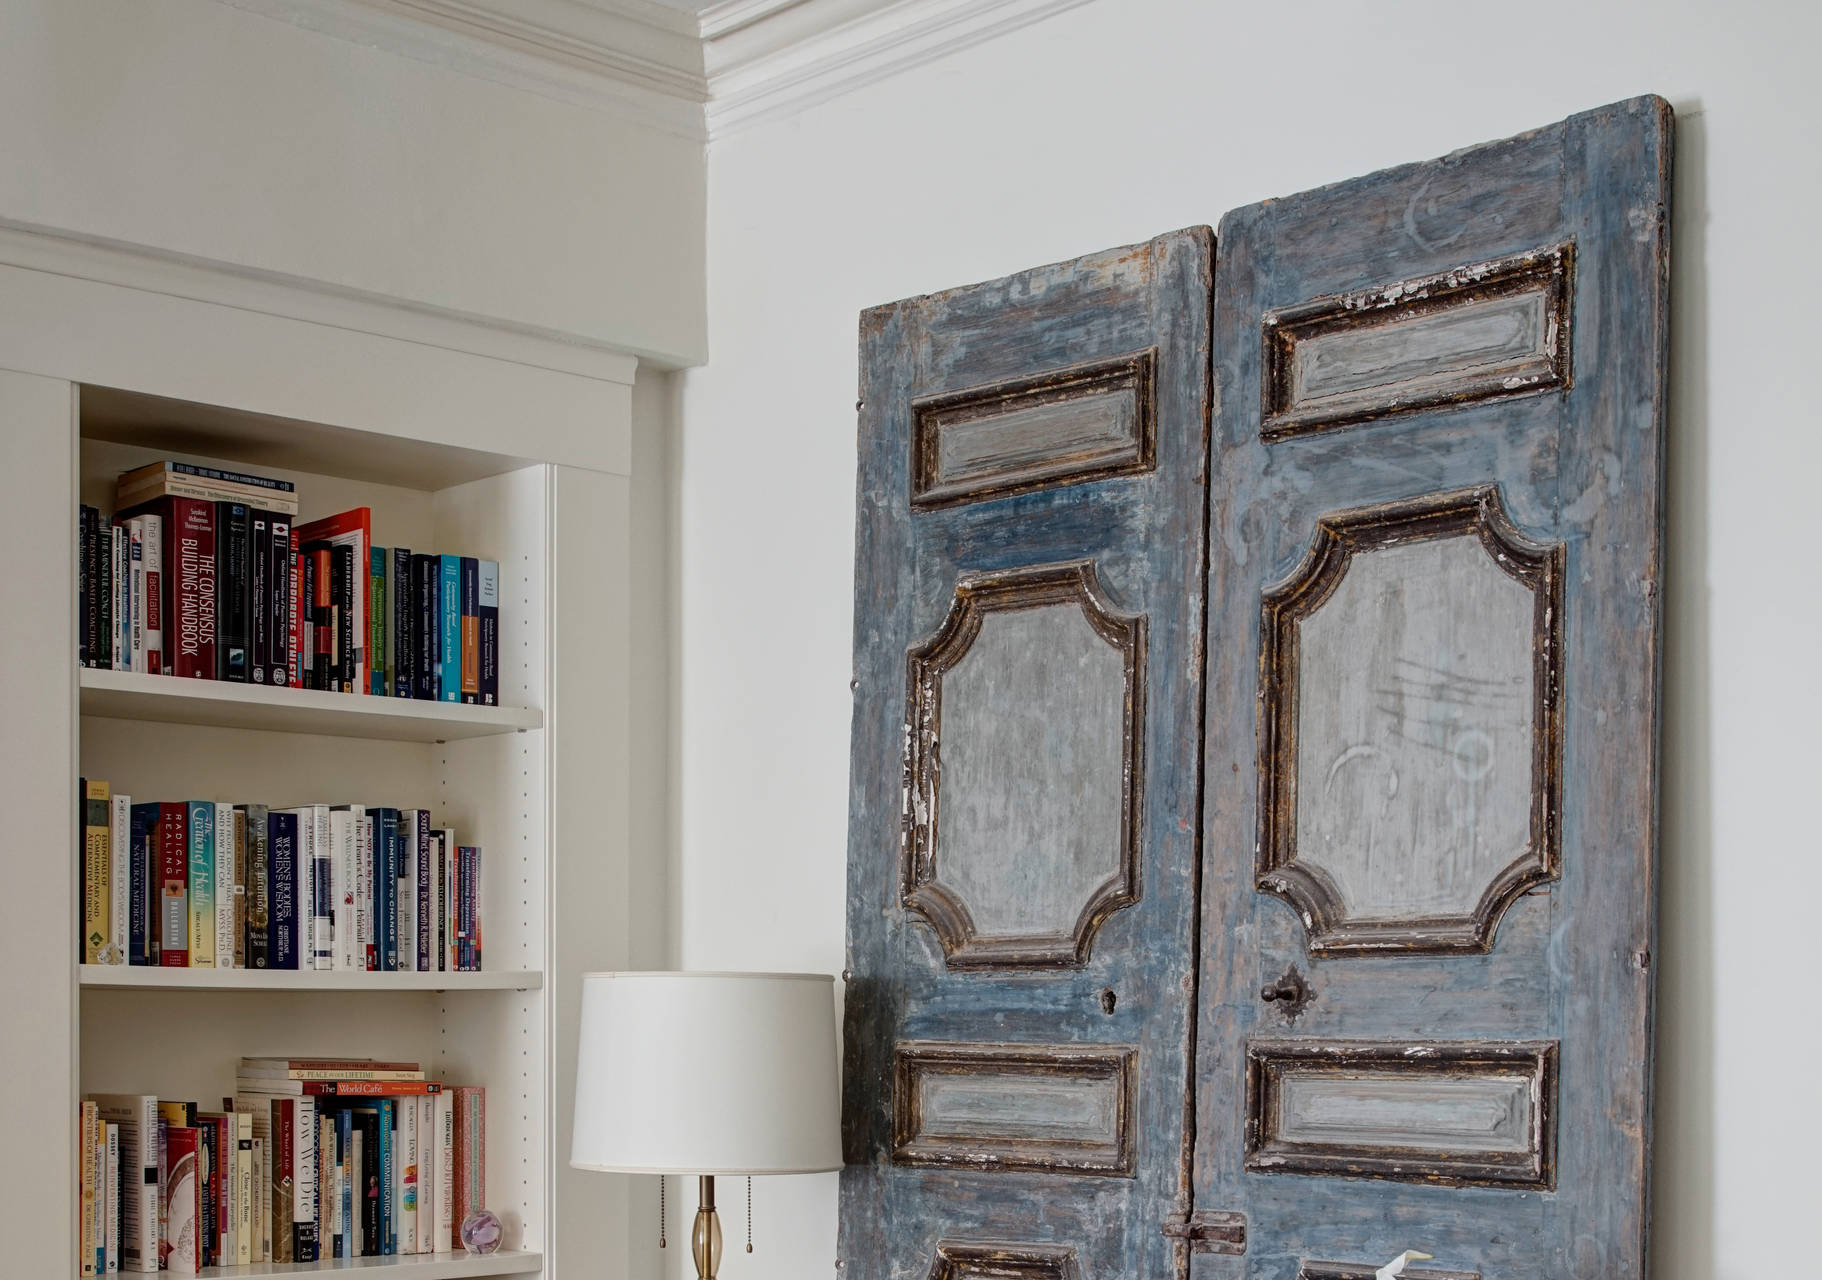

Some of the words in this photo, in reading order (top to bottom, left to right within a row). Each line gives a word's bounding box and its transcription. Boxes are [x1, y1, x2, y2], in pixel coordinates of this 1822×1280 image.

[149, 522, 158, 537] the
[149, 542, 158, 556] art
[149, 559, 158, 569] of
[181, 538, 198, 590] BUILDING
[200, 554, 214, 574] THE
[149, 576, 158, 627] facilitation
[200, 578, 214, 644] CONSENSUS
[181, 593, 198, 656] HANDBOOK
[192, 808, 211, 850] Creation
[356, 820, 364, 836] The
[419, 814, 428, 832] Sound
[255, 818, 265, 868] Awakening
[192, 855, 211, 867] of
[275, 837, 283, 880] WOMEN'S
[283, 837, 291, 880] WOMEN'S
[419, 852, 428, 869] Sound
[192, 871, 211, 906] Health
[256, 873, 265, 913] Intuition
[356, 874, 364, 898] Code
[419, 871, 428, 886] Body
[275, 882, 283, 921] WISDOM
[170, 902, 179, 946] BALLENTINE
[320, 1084, 335, 1093] The
[338, 1084, 362, 1094] World
[363, 1084, 382, 1094] Café
[301, 1101, 314, 1139] How
[86, 1145, 93, 1153] OF
[301, 1146, 314, 1175] We
[301, 1182, 314, 1212] Die
